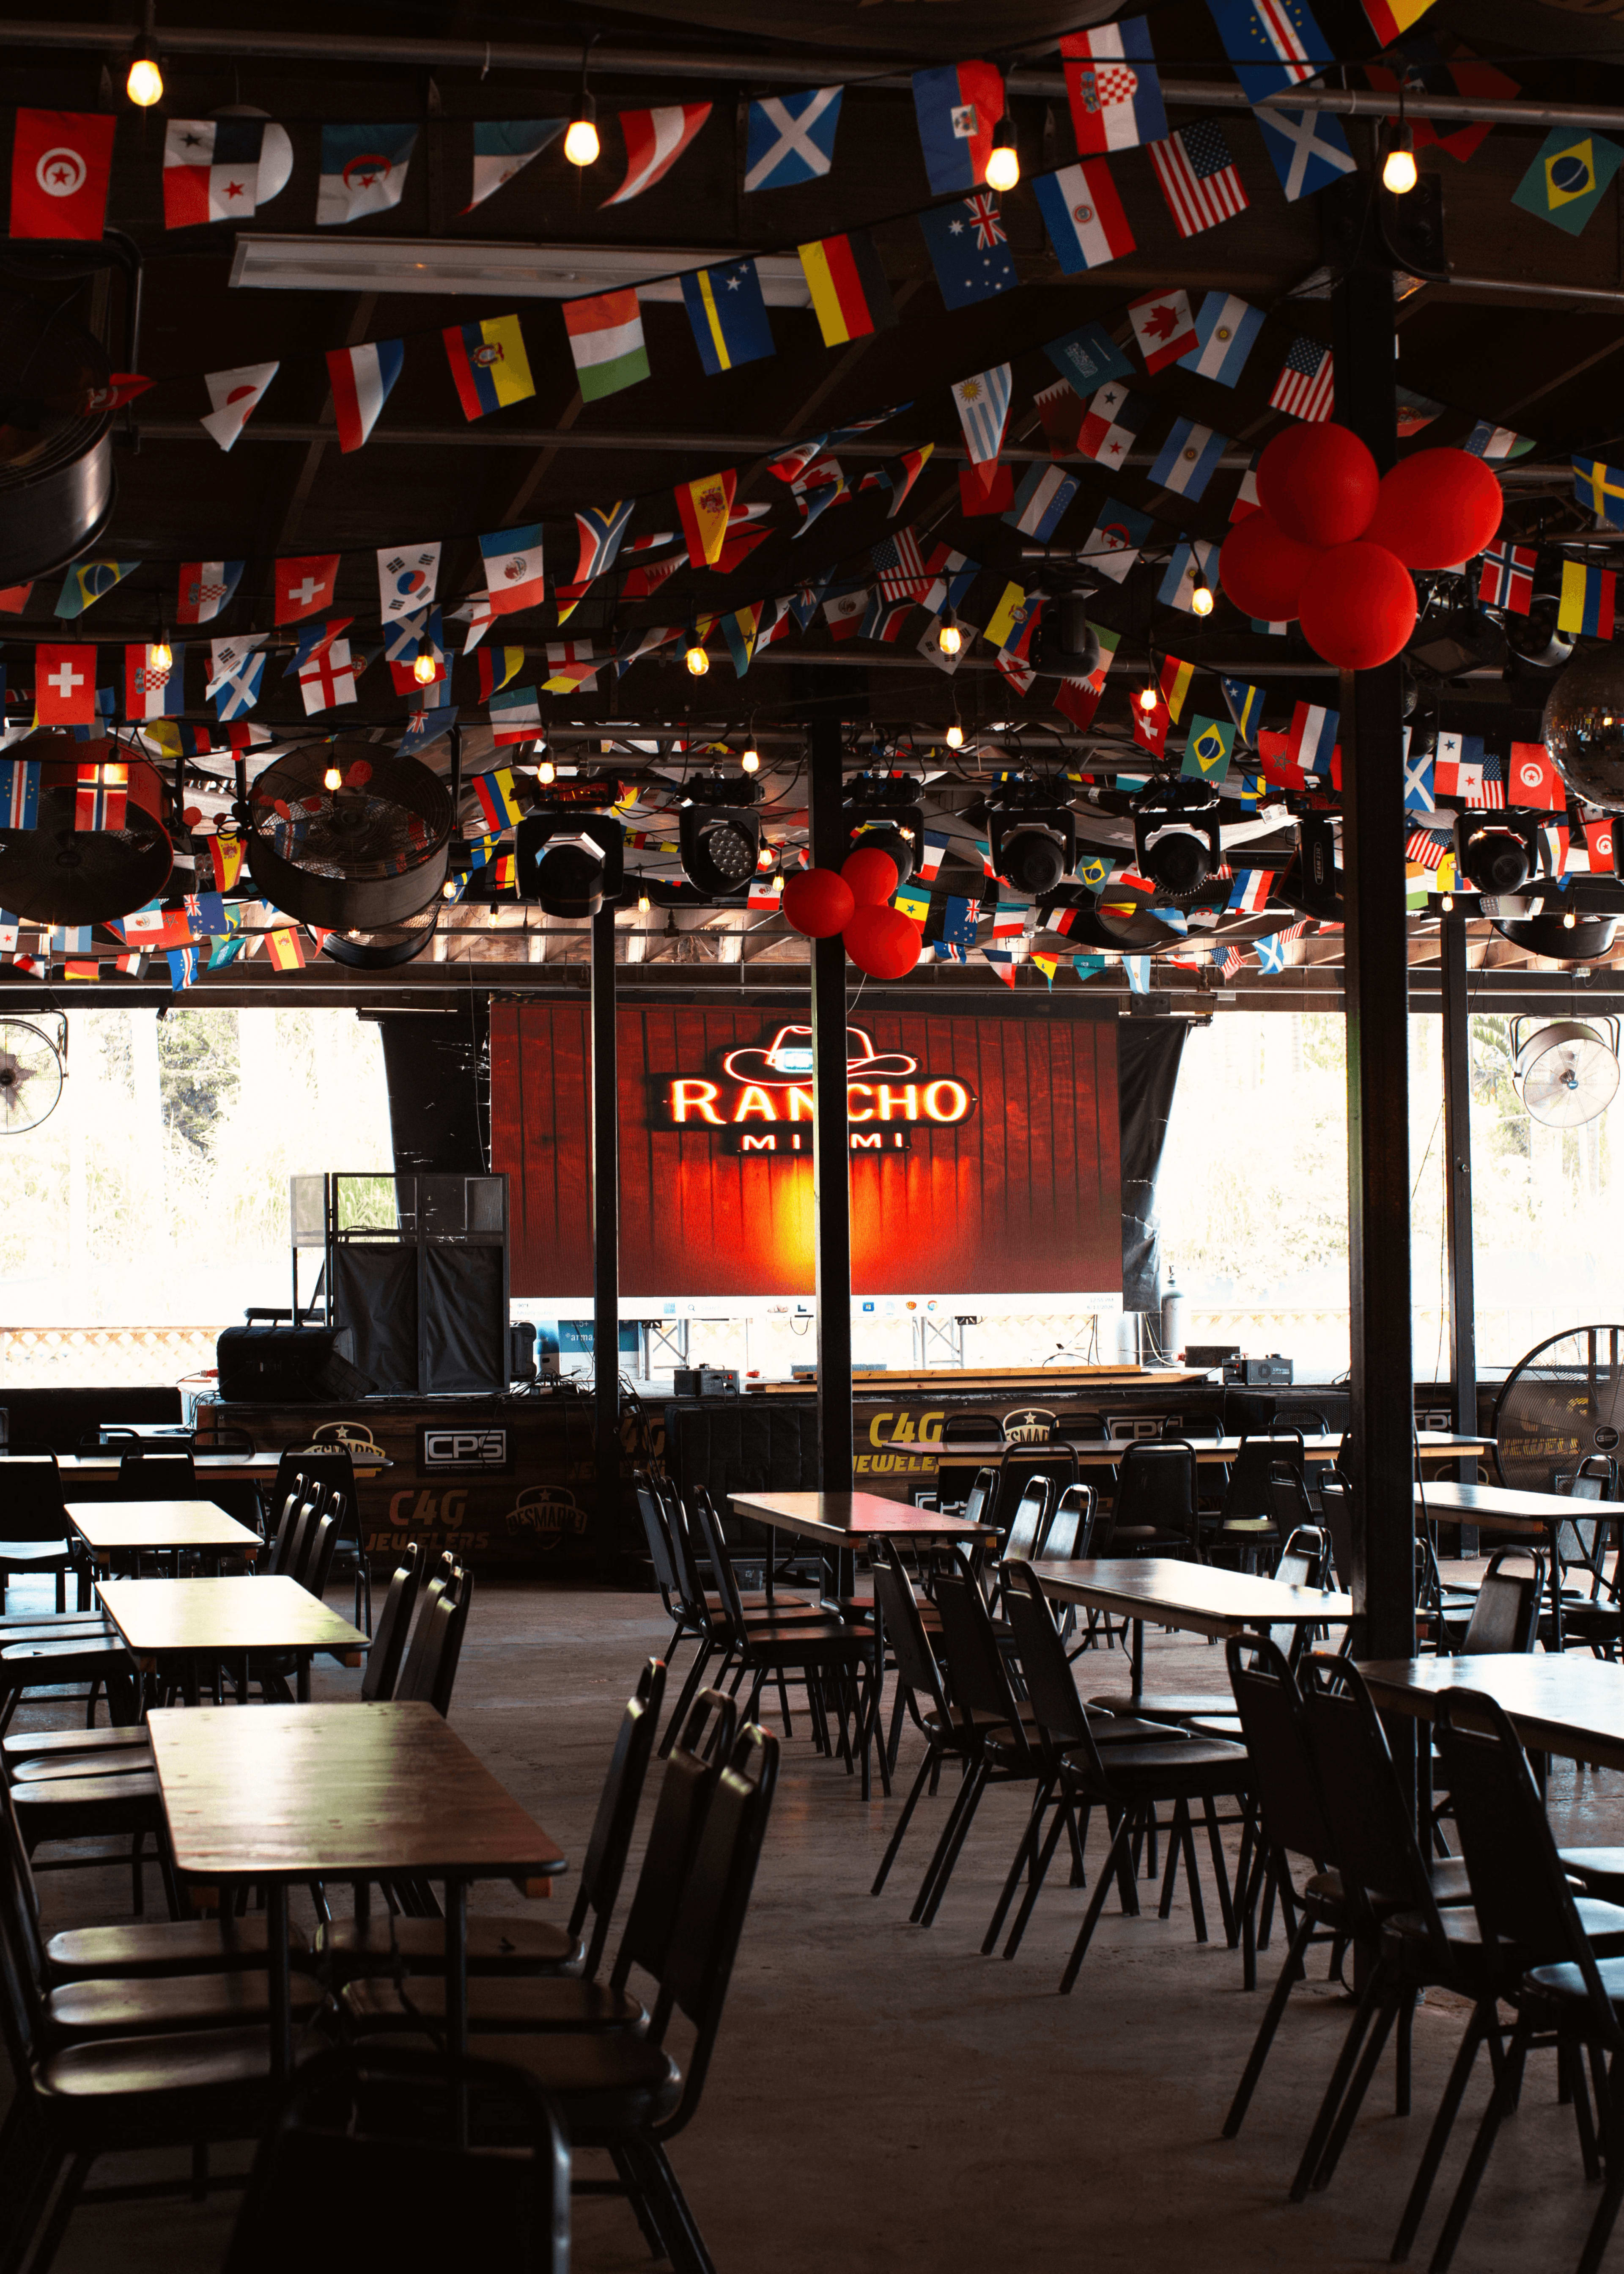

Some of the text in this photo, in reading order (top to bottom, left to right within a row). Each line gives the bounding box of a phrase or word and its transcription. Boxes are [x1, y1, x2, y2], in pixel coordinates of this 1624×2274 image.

[672, 1079, 968, 1125] RANCHO
[743, 1133, 903, 1150] MIMI
[869, 1412, 945, 1447] C4G
[428, 1435, 503, 1459] CPS
[389, 1489, 469, 1530] C4G
[365, 1532, 490, 1552] JEWELERS
